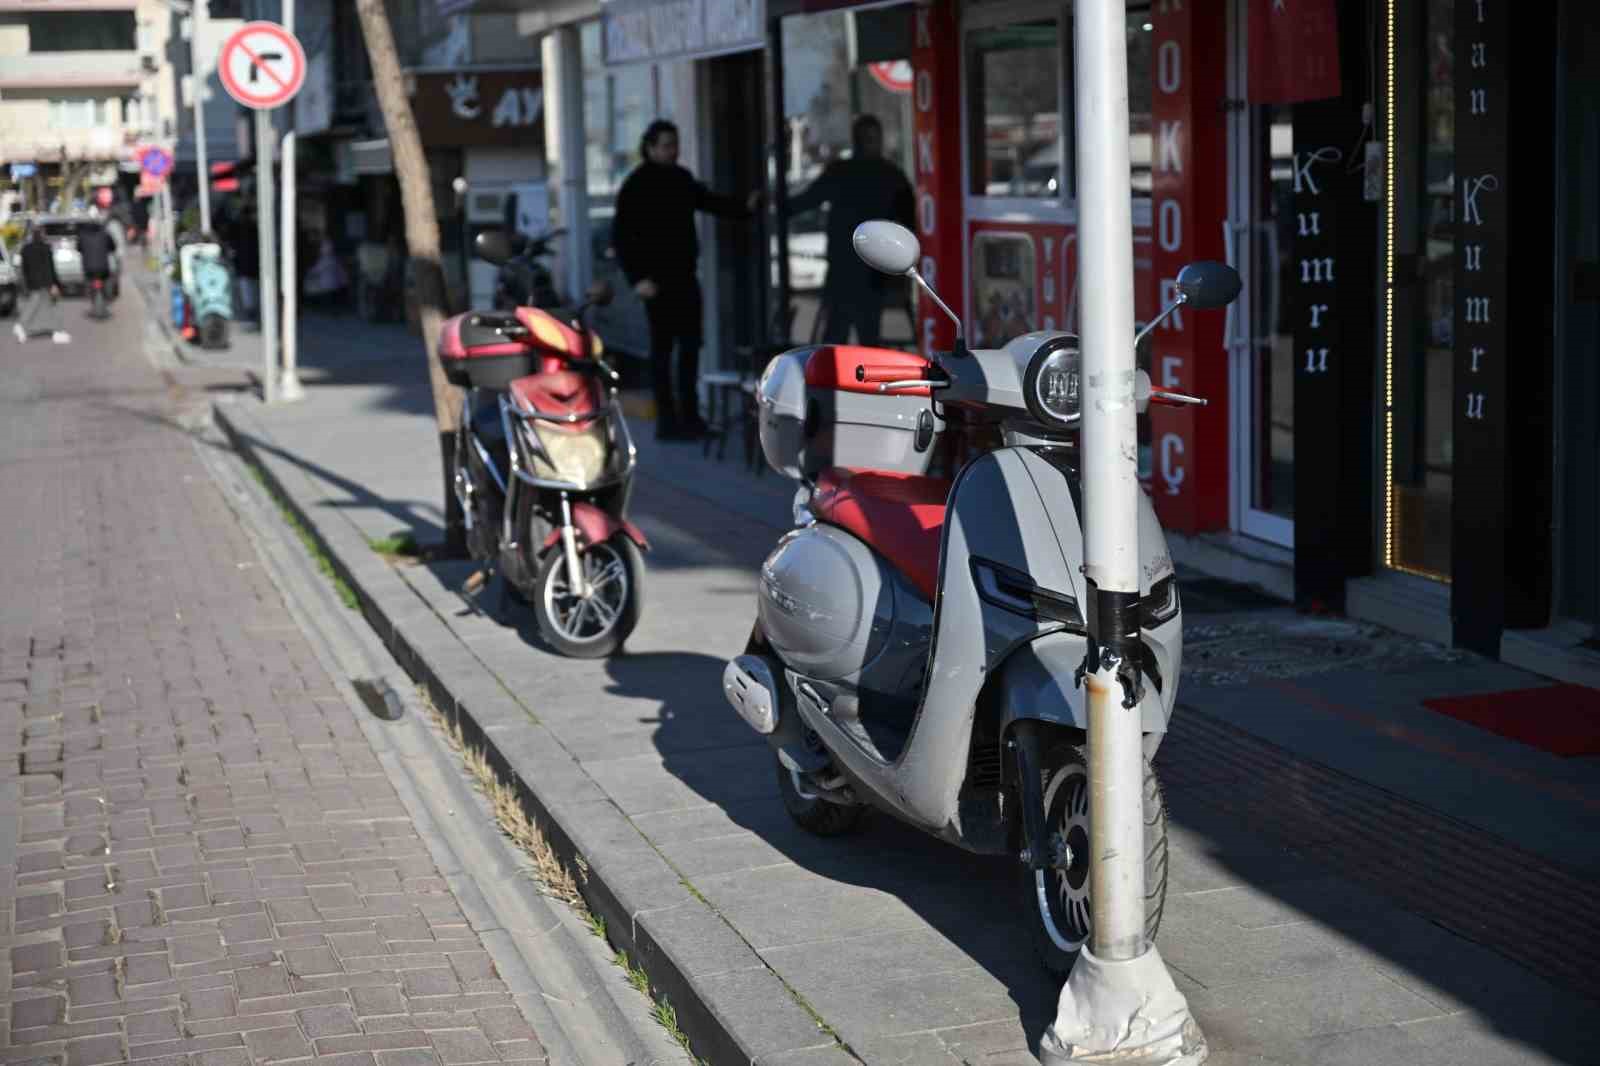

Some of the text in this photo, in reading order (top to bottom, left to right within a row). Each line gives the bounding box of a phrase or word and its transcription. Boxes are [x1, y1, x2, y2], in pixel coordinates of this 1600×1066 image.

[1158, 0, 1184, 496] OKOREÇ
[1292, 146, 1342, 373] Kumru
[1463, 174, 1498, 420] Kumru
